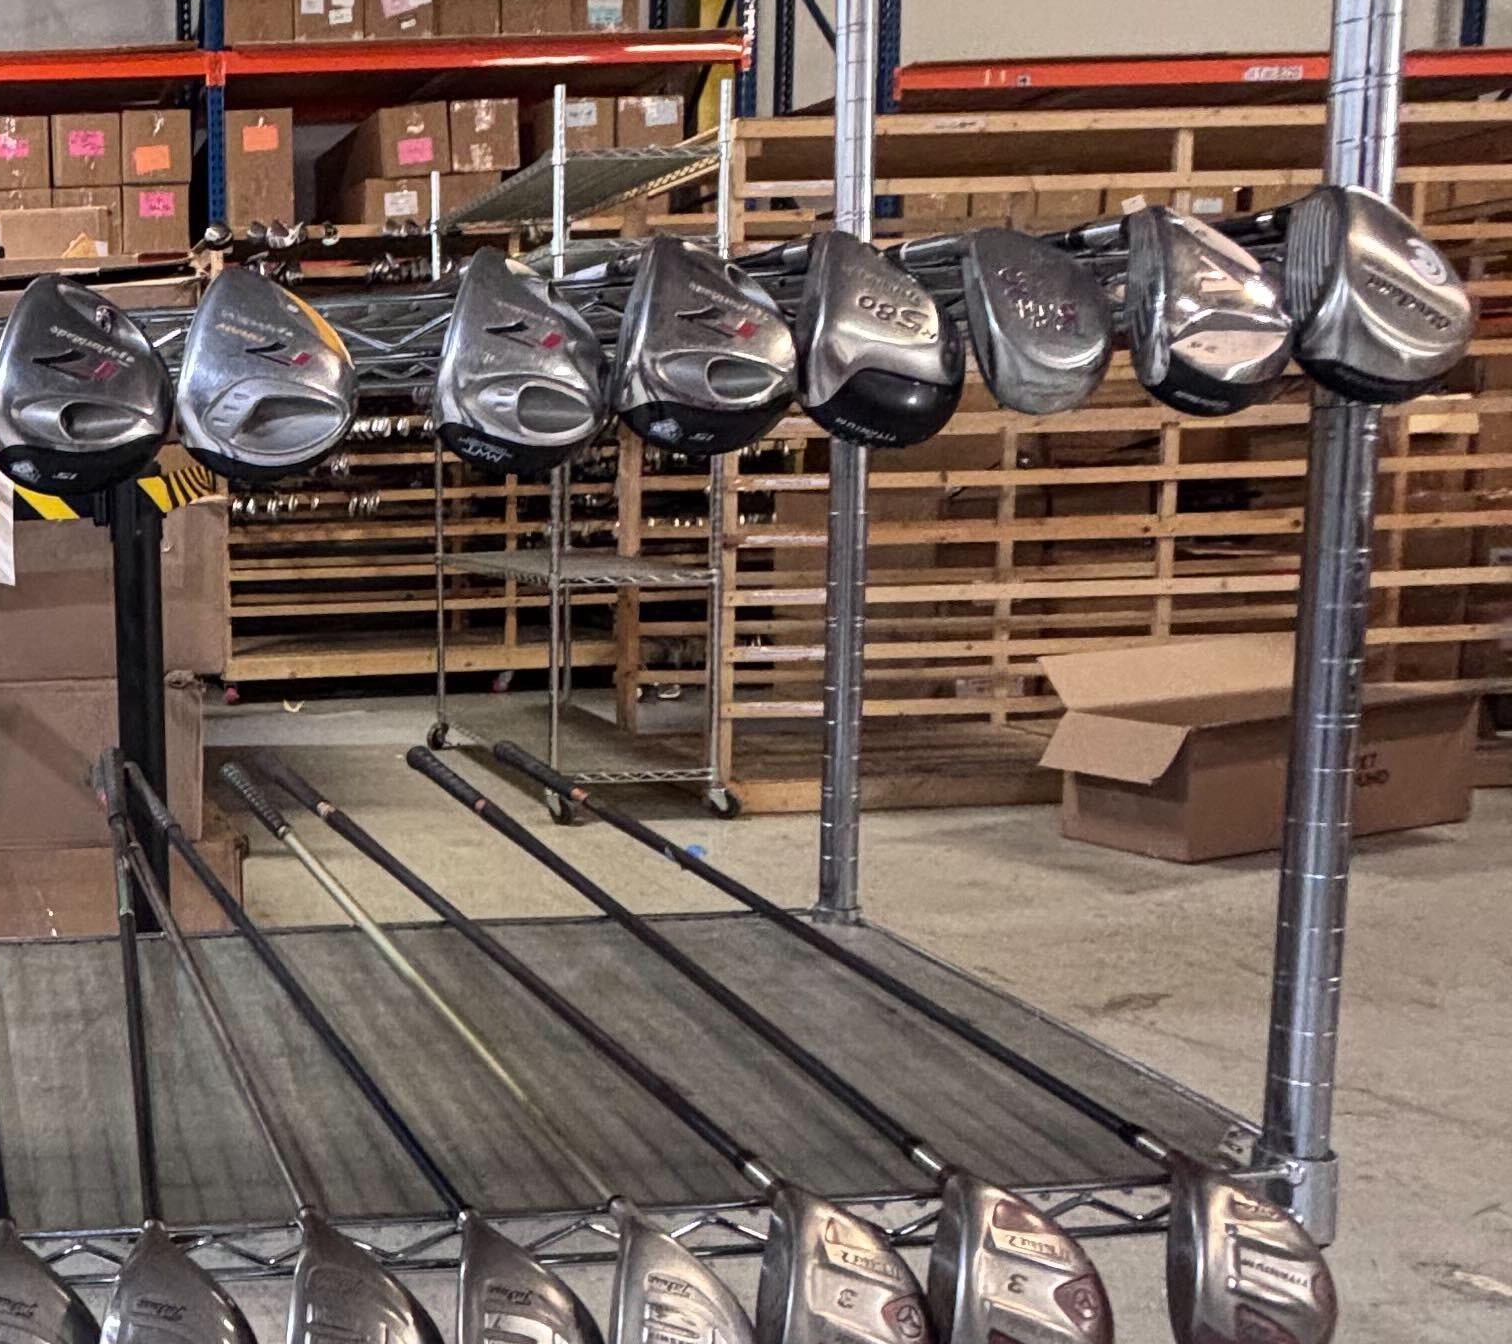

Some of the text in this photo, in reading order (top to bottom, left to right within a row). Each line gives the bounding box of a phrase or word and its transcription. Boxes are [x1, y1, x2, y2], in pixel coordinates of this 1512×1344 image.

[48, 324, 135, 364] TaylorMade
[1007, 1275, 1028, 1294] 3
[135, 1298, 187, 1322] Titleist
[837, 1289, 857, 1309] 3
